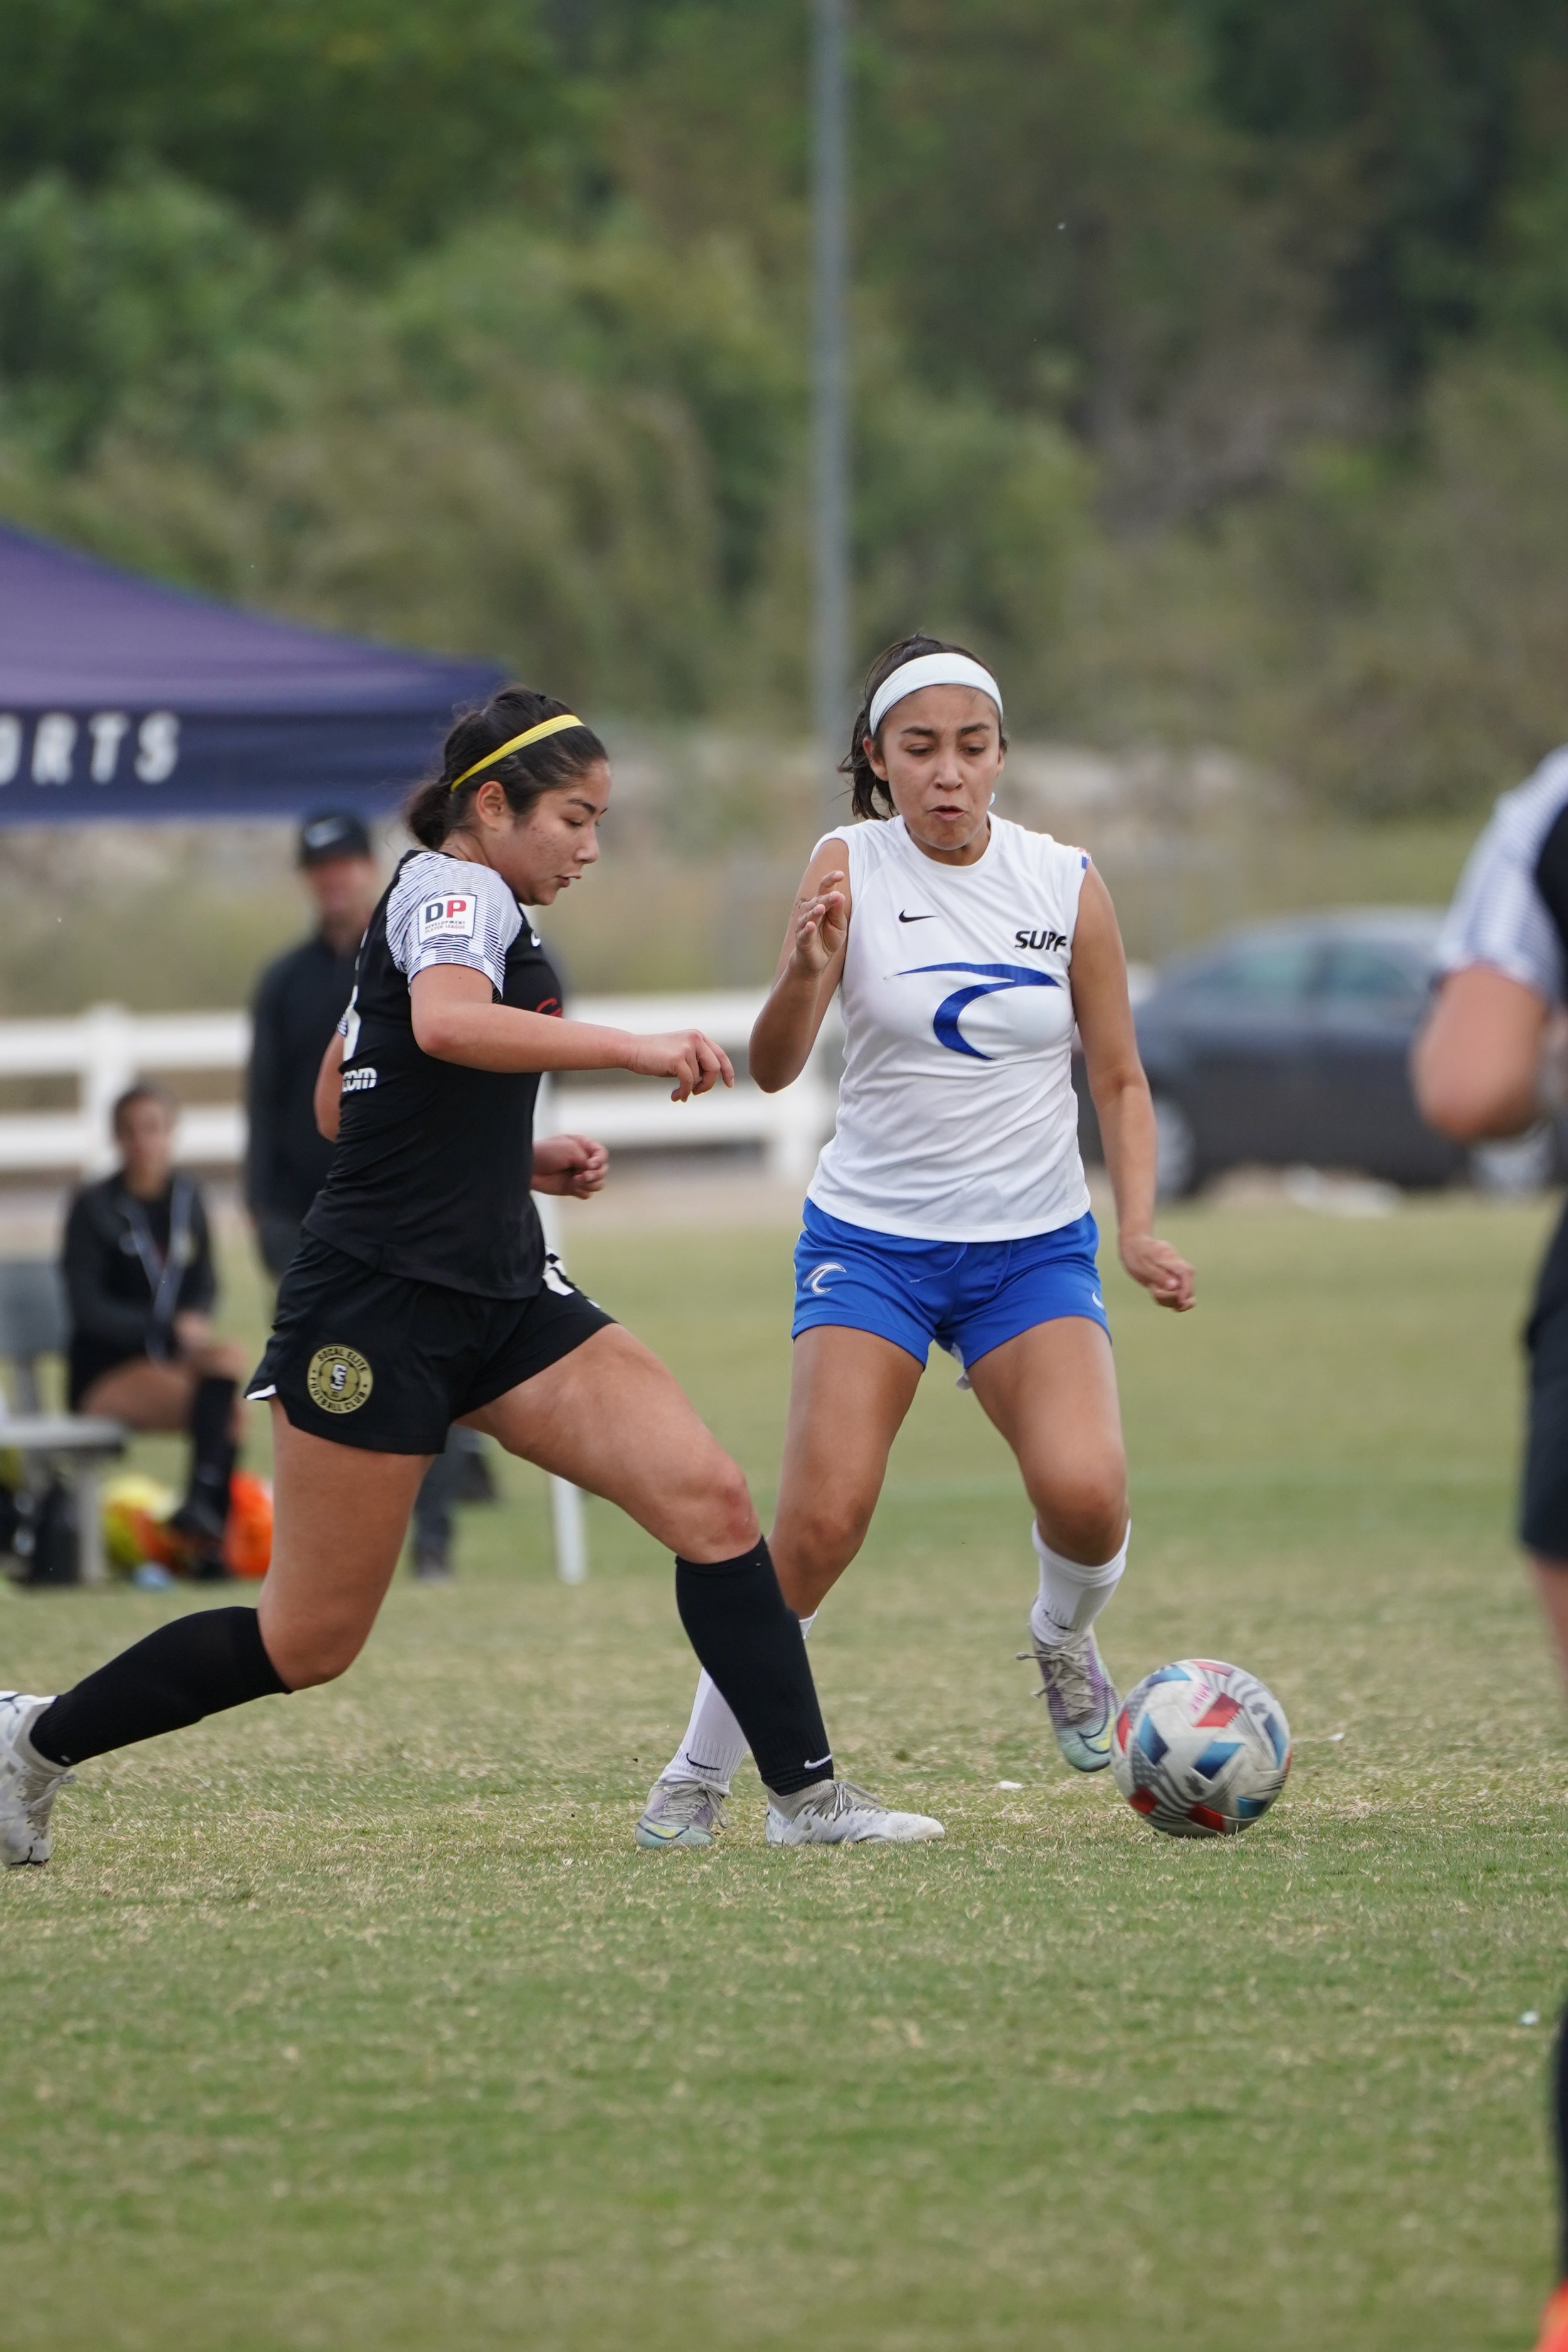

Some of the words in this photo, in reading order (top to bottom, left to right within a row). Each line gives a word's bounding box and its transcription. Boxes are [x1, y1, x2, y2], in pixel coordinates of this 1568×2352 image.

[425, 899, 467, 924] DP
[425, 920, 465, 930] DEVELOPMENT
[1015, 930, 1067, 951] SURF
